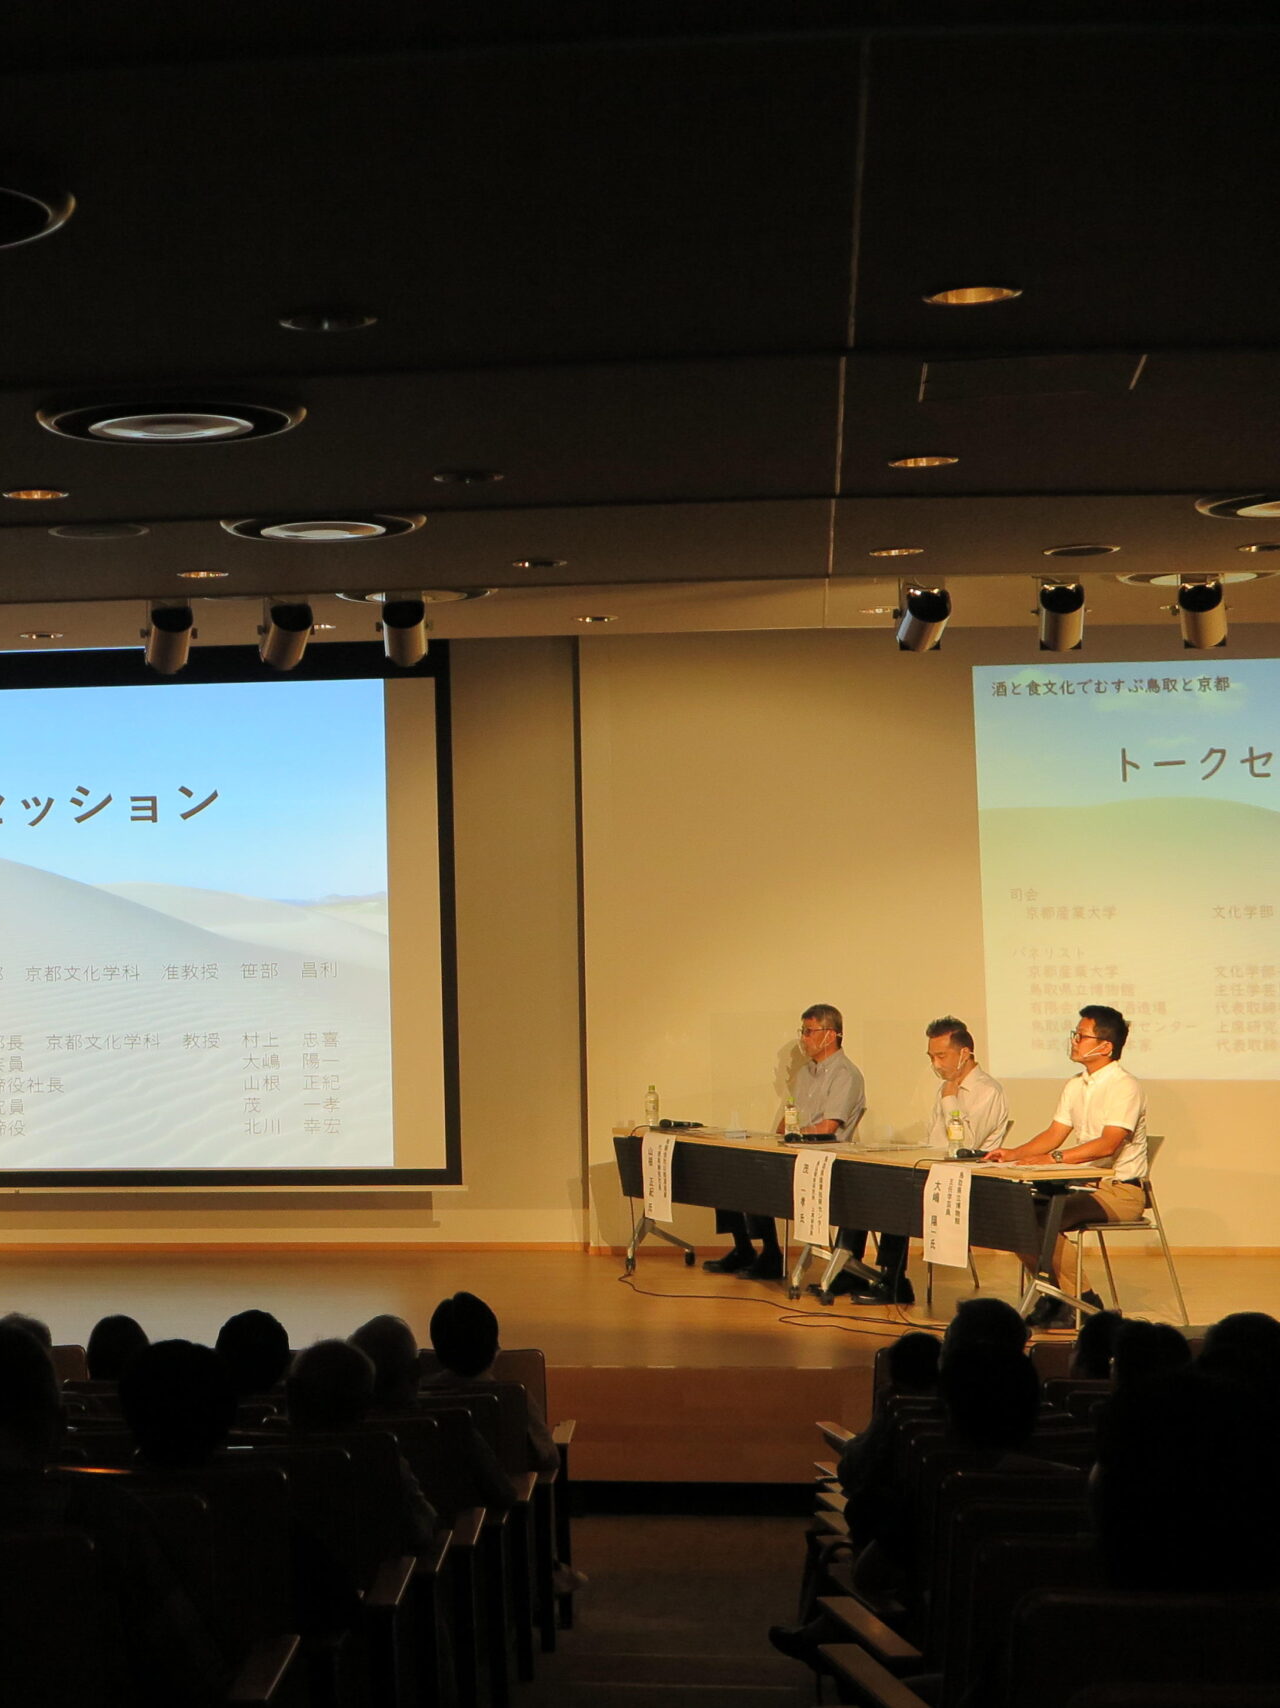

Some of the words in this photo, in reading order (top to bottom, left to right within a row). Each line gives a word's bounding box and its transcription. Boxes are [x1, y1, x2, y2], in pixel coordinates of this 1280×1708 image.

[992, 676, 1230, 697] 酒と食文化でむすぶ鳥取と京都
[1121, 746, 1273, 782] トークセ
[1010, 888, 1038, 901] 司会
[1026, 905, 1117, 920] 京都産業大学
[1212, 905, 1274, 919] 文化学部
[25, 964, 140, 982] 京都文化学科
[161, 963, 218, 980] 准教授
[241, 962, 279, 979] 笹部
[301, 961, 338, 978] 昌利
[46, 1033, 160, 1050] 京都文化学科
[183, 1032, 221, 1049] 教授
[242, 1032, 280, 1049] 村上
[302, 1032, 339, 1048] 忠喜
[243, 1054, 281, 1070] 大嶋
[302, 1053, 339, 1070] 陽一
[243, 1075, 281, 1092] 山根
[303, 1075, 340, 1091] 正紀
[244, 1097, 261, 1113] 茂
[304, 1097, 340, 1113] 一孝
[244, 1119, 281, 1135] 北川
[304, 1118, 341, 1135] 幸宏
